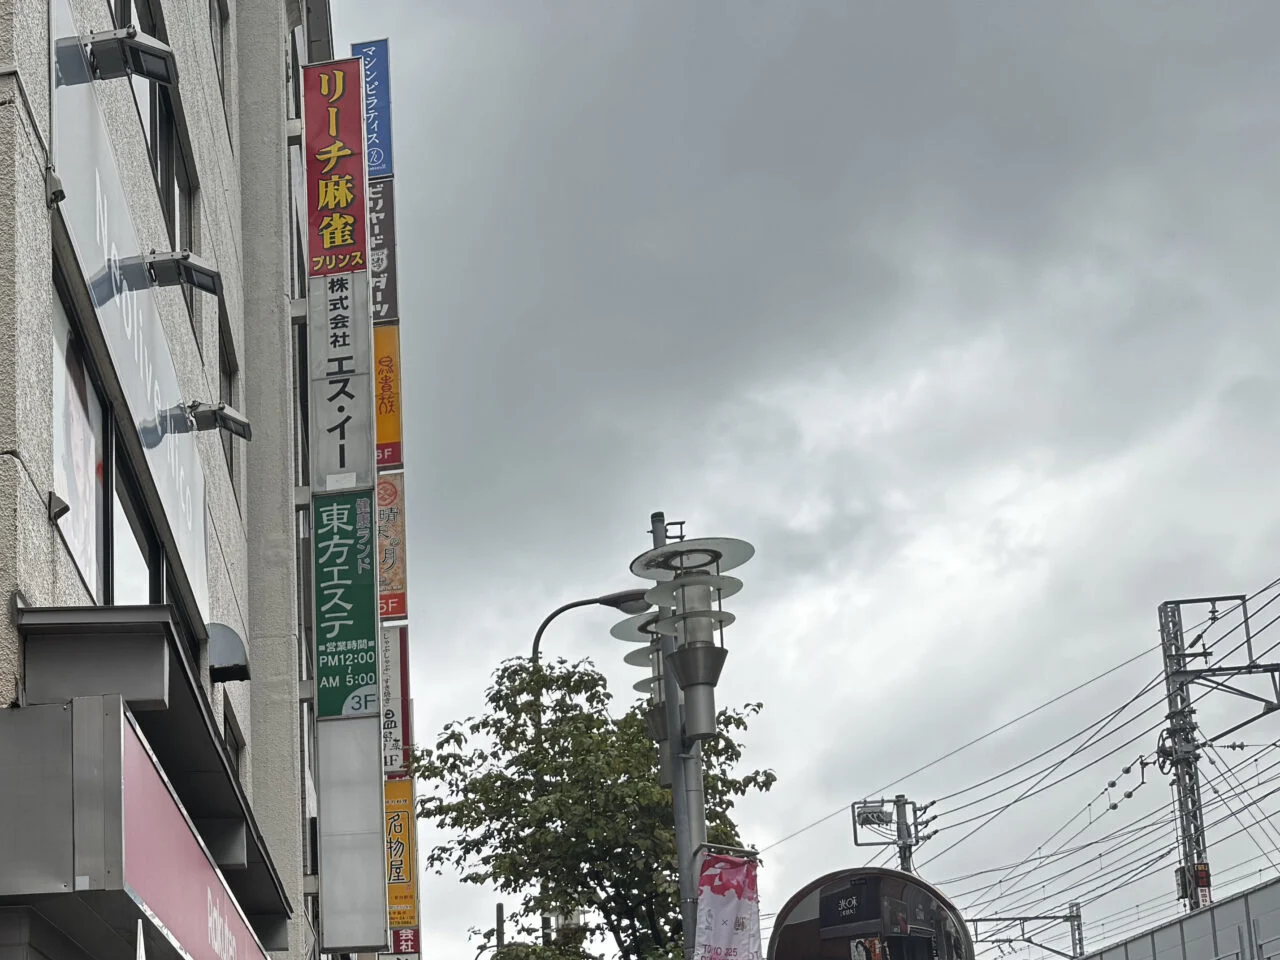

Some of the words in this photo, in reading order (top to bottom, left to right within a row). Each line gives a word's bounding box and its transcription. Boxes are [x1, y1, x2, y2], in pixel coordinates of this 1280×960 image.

[363, 46, 379, 144] マシンピラティス
[315, 70, 354, 249] リーチ麻雀
[312, 252, 363, 271] プリンス
[96, 167, 162, 436] Neolive
[328, 277, 350, 348] 株式会社
[326, 356, 356, 468] エス・イー
[318, 503, 354, 638] 東方エステ
[320, 675, 339, 688] AM
[346, 672, 375, 686] 5:00
[326, 641, 368, 652] 営業時間
[351, 694, 376, 711] 3F
[387, 814, 405, 882] 名物屋
